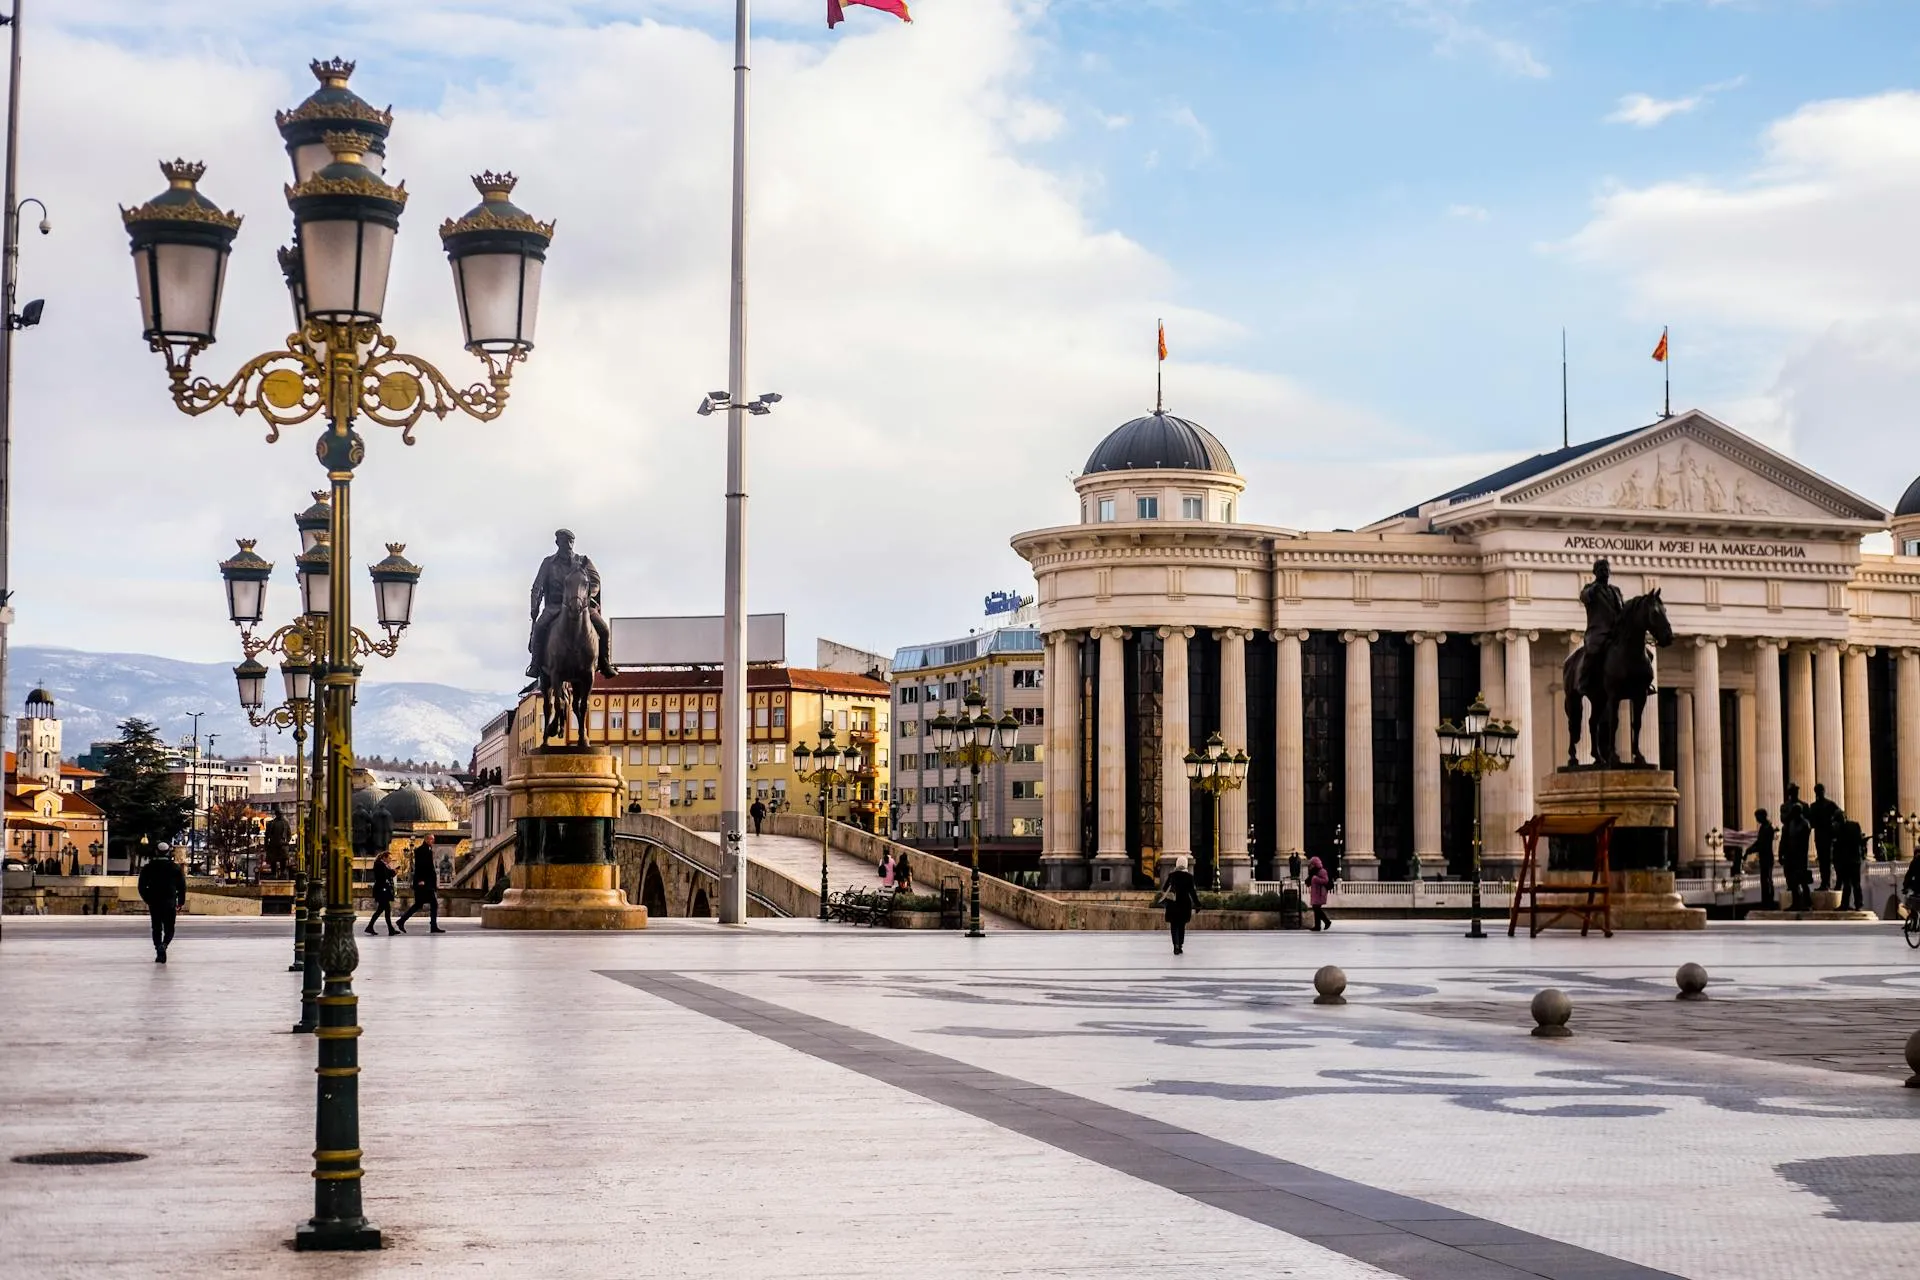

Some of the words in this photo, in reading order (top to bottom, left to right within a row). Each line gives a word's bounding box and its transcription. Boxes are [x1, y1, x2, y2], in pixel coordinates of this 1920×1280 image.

[1565, 536, 1653, 551] АРХЕОЛОШКИ
[1659, 540, 1694, 554] МУЗЕЈ
[1699, 541, 1717, 554] НА
[1721, 543, 1806, 558] МАКЕДОНИЈА
